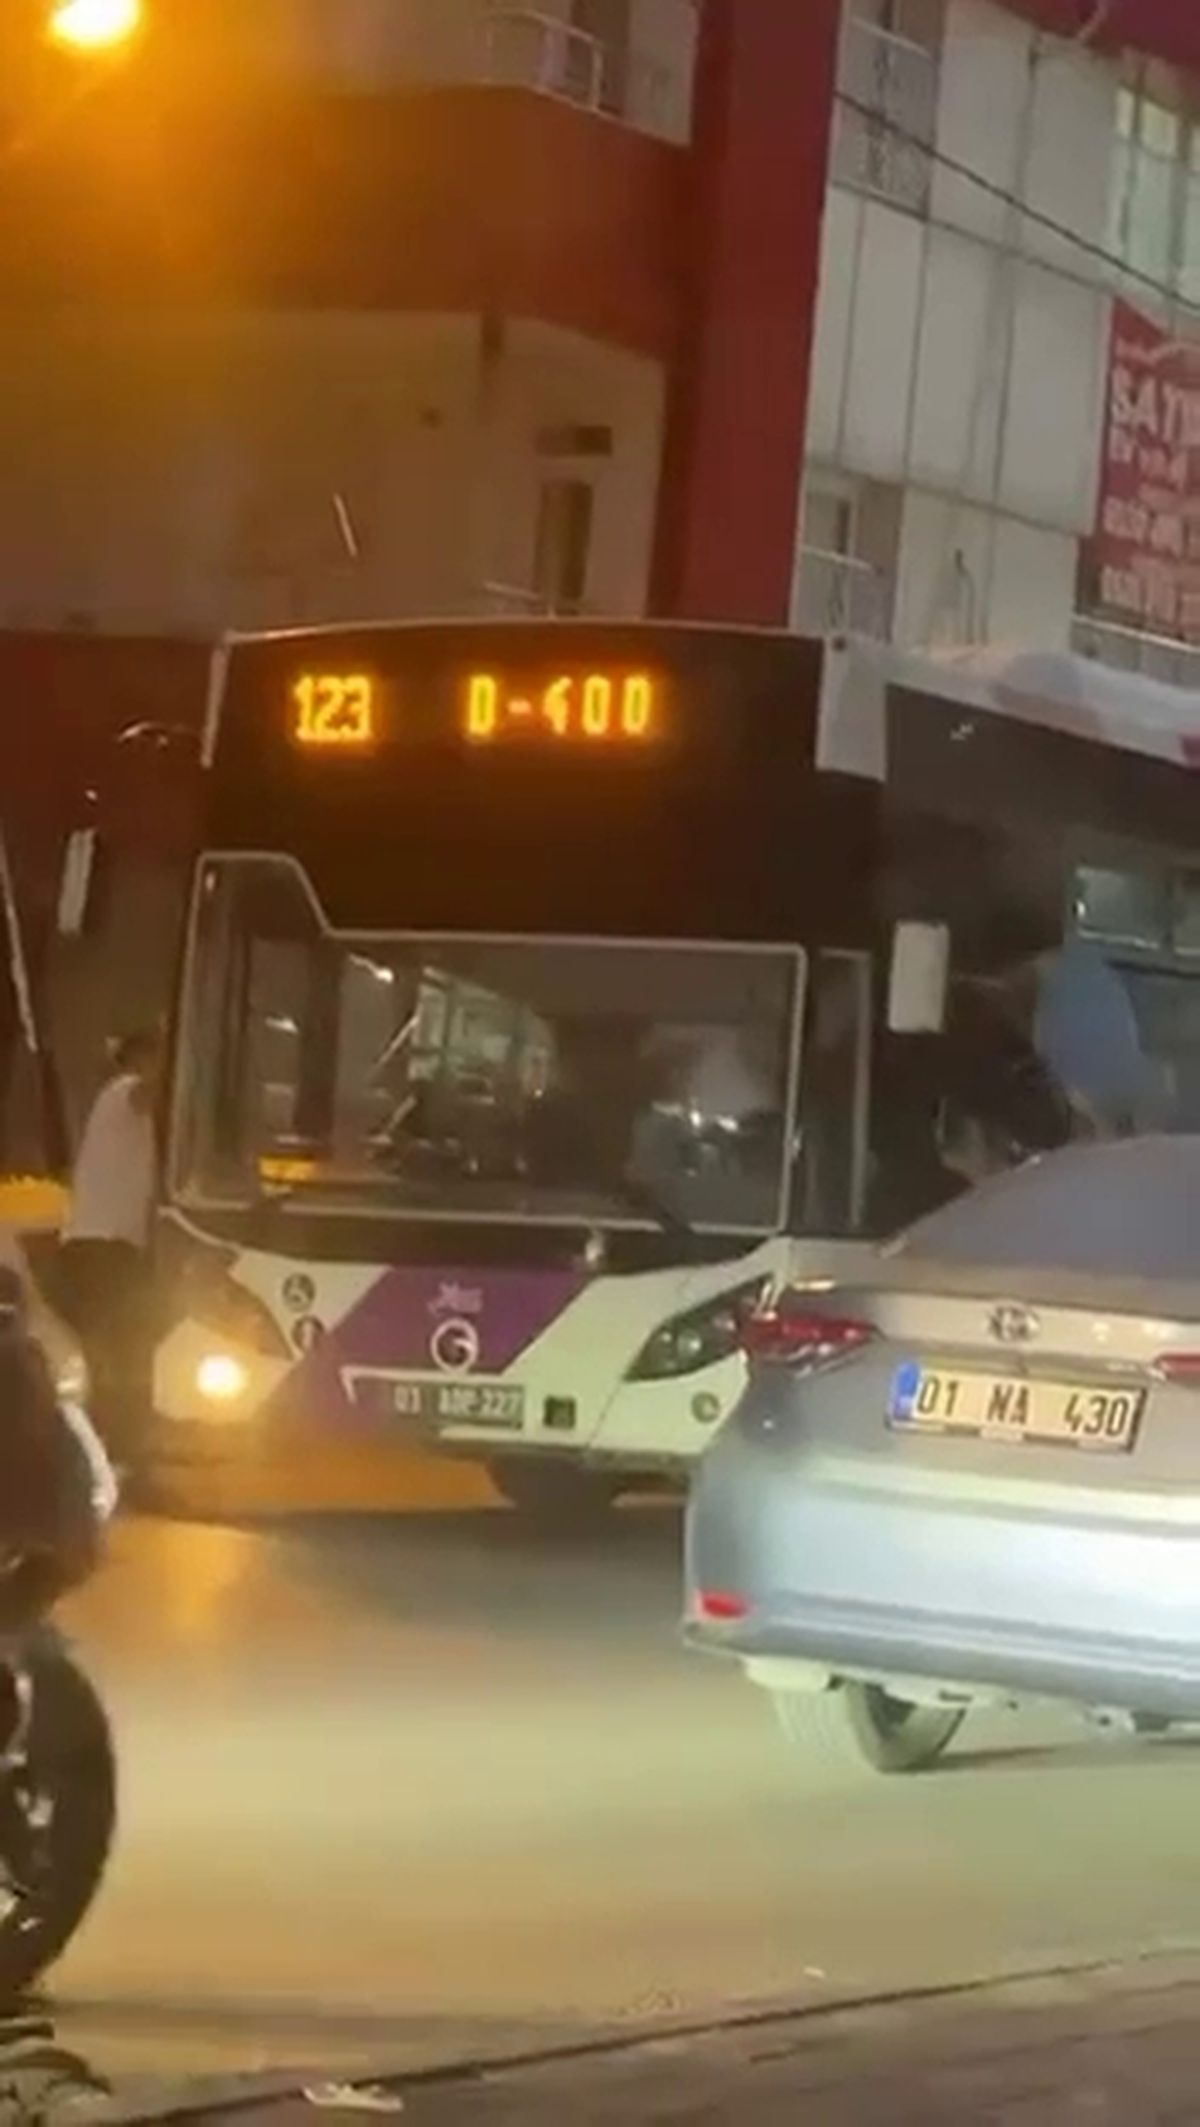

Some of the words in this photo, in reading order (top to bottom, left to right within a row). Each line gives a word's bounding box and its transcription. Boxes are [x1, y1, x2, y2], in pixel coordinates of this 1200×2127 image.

[295, 675, 372, 742] 123
[917, 1376, 958, 1417] 01
[986, 1384, 1030, 1426] NA
[1064, 1393, 1130, 1438] 430
